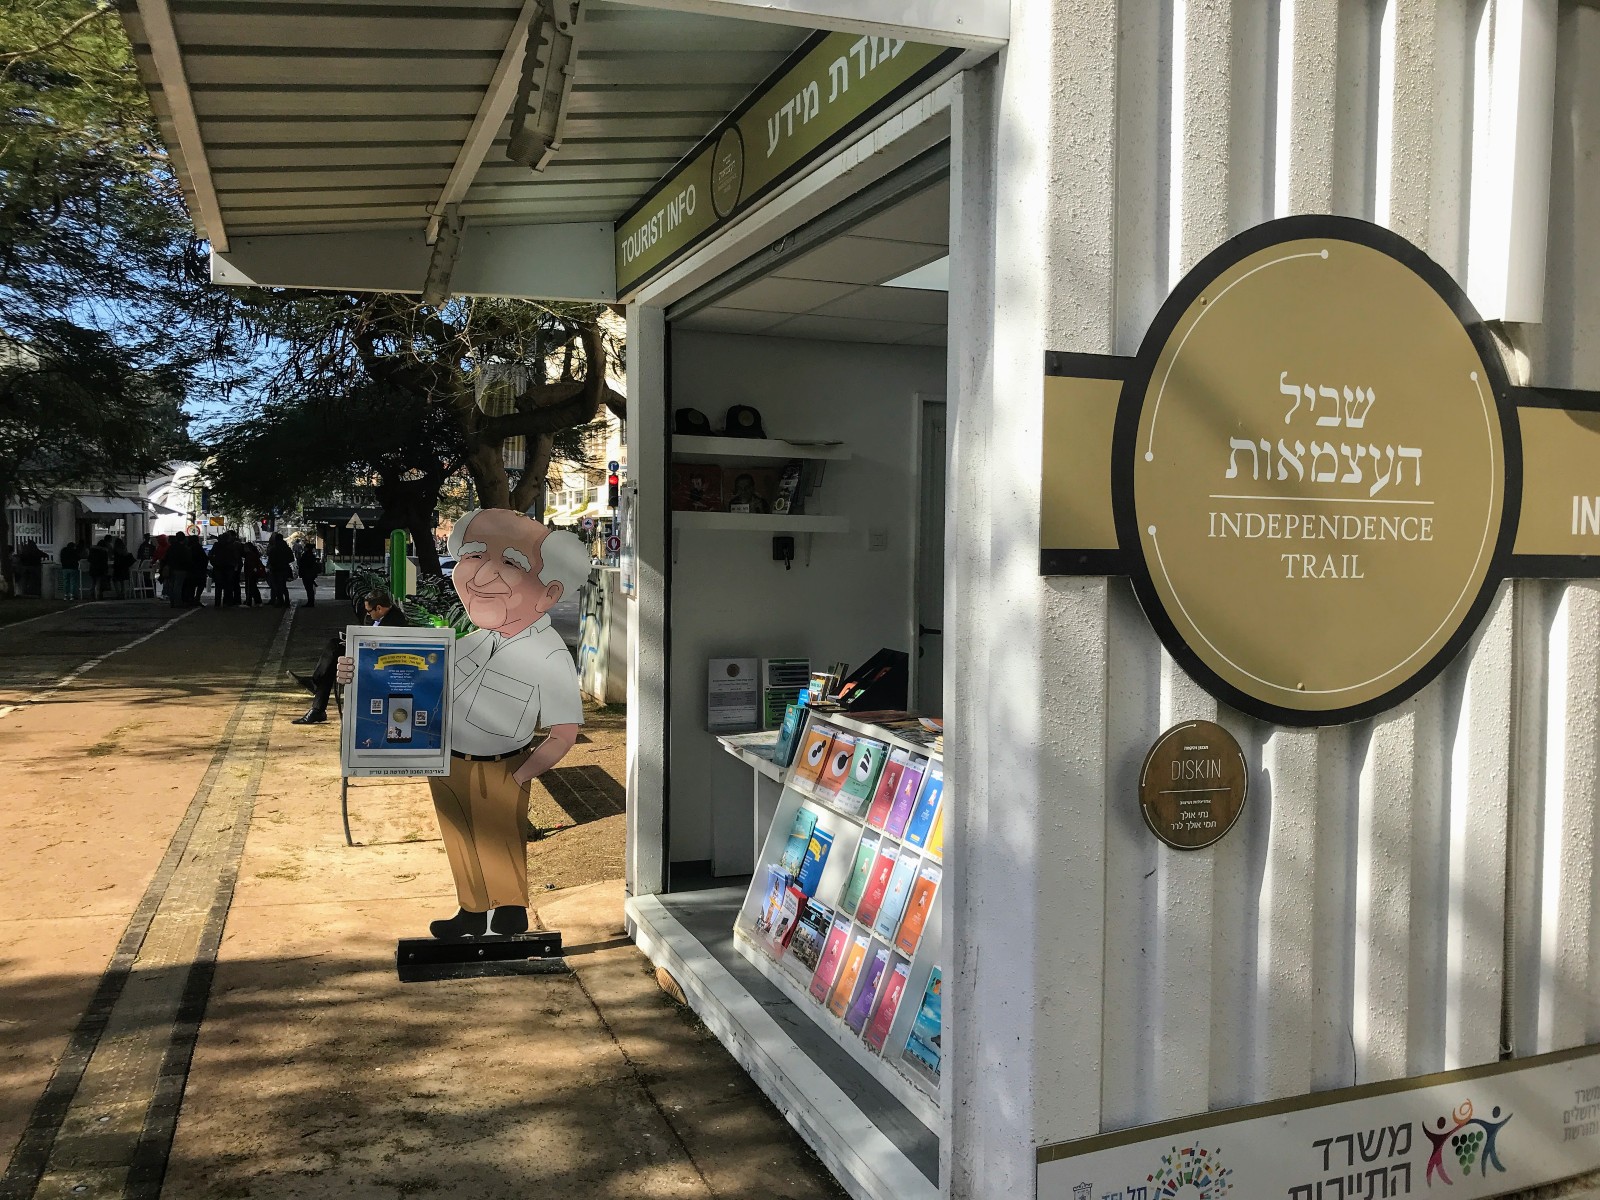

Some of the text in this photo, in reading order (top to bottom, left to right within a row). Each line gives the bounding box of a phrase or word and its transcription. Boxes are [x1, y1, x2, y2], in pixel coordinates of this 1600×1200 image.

[766, 80, 820, 158] מידע
[621, 184, 696, 267] TOURIST INFO
[1279, 371, 1376, 428] שביל
[1225, 436, 1423, 498] העצמאות
[15, 525, 42, 535] Kiosk
[1207, 512, 1434, 541] INDEPENDENCE
[1280, 554, 1365, 579] TRAIL
[1171, 758, 1221, 781] DISKIN
[1180, 810, 1209, 821] נתי אולך
[1203, 820, 1217, 829] תמי
[1312, 1122, 1412, 1171] משרד
